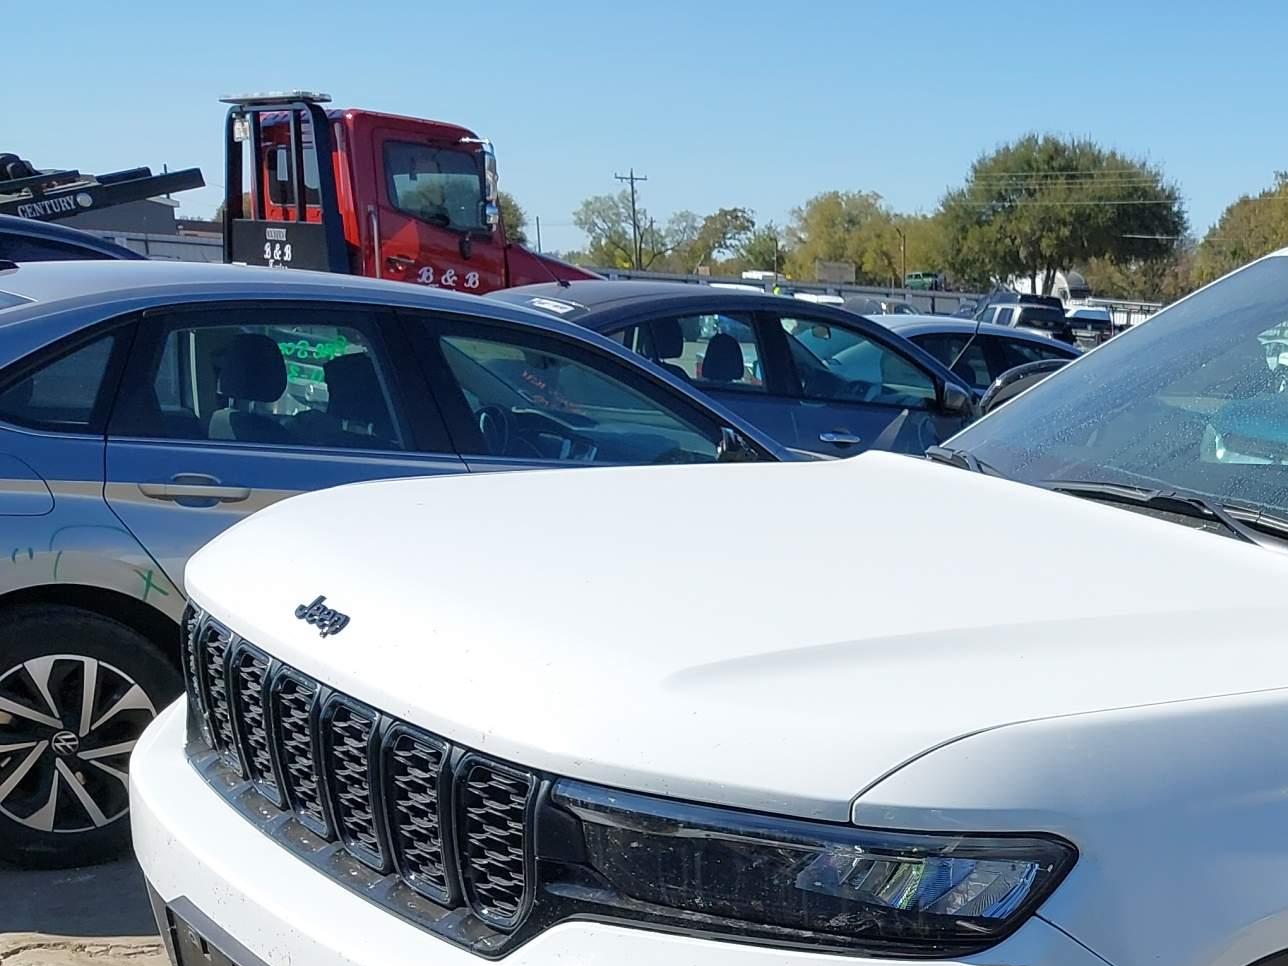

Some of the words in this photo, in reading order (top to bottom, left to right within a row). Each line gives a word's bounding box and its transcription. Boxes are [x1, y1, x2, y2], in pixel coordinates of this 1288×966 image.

[17, 195, 76, 219] CENTURY
[263, 242, 272, 259] B
[273, 243, 282, 260] &
[283, 243, 292, 261] B
[416, 266, 434, 284] B
[441, 268, 458, 287] &
[463, 271, 480, 289] B
[294, 594, 351, 636] Jeep
